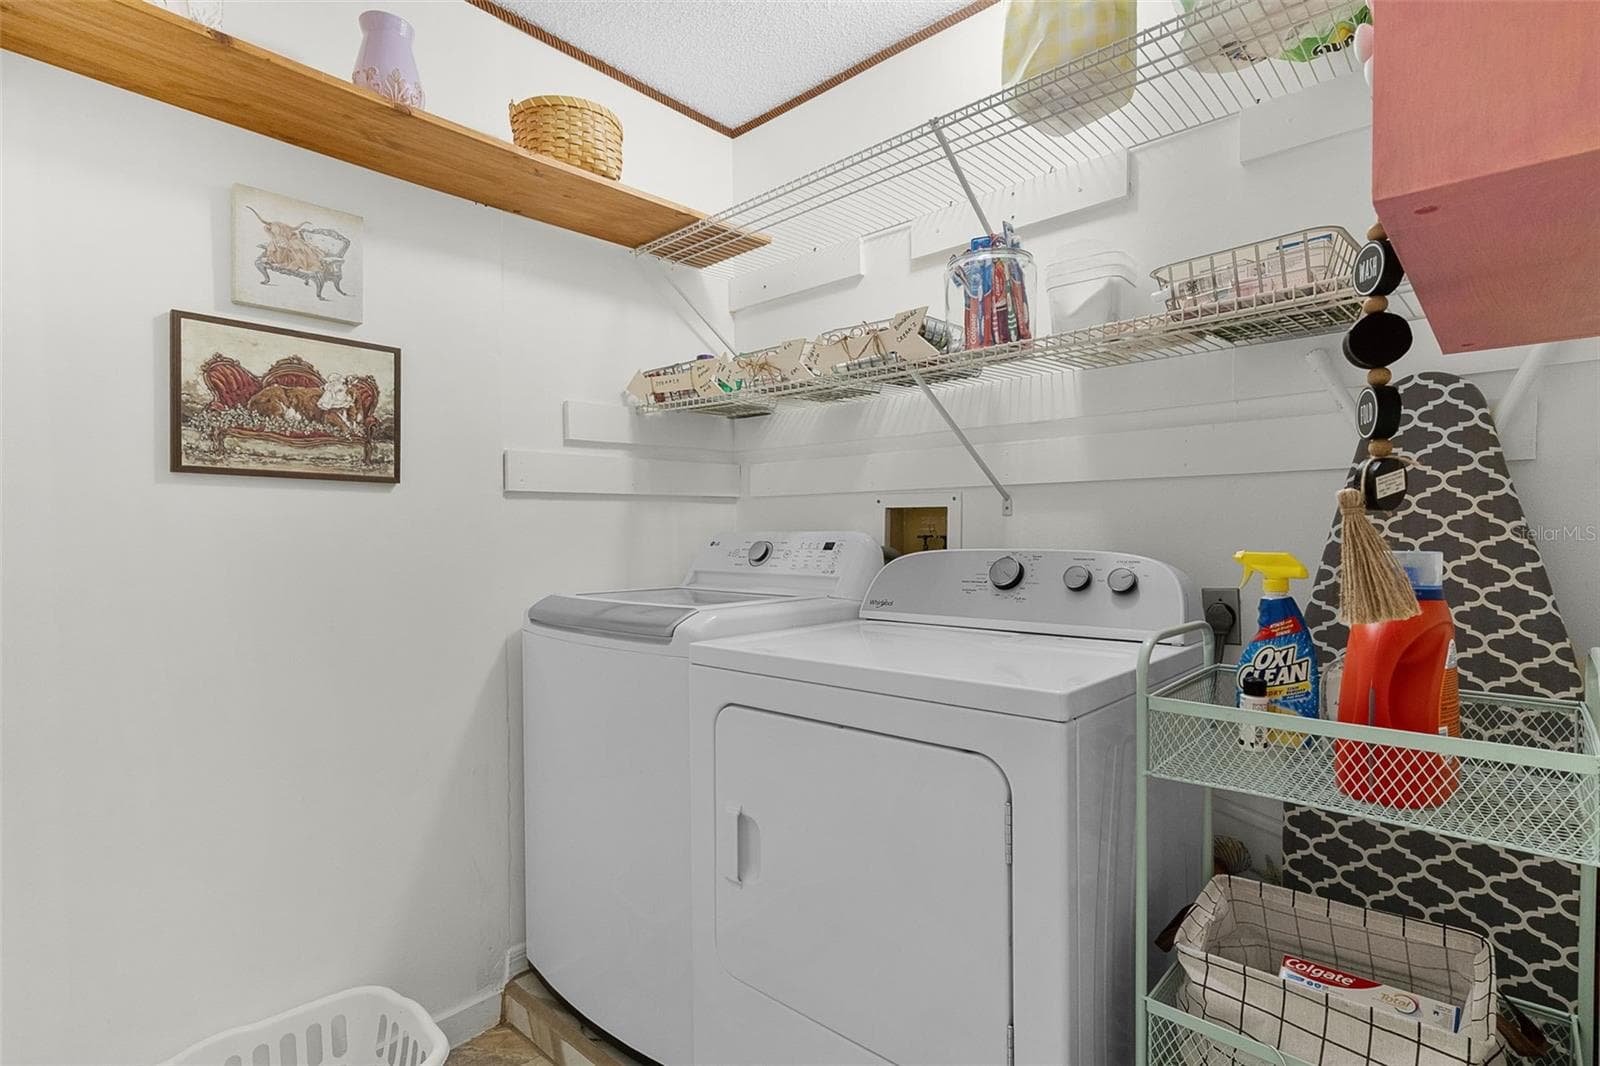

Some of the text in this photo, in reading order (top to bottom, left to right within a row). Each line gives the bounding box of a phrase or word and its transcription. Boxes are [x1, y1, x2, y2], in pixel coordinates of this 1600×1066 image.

[1358, 256, 1378, 284] WASH
[1359, 402, 1373, 426] FOLD
[1254, 646, 1297, 670] OXI
[1285, 958, 1354, 986] Colgate
[1380, 992, 1412, 1009] Total
